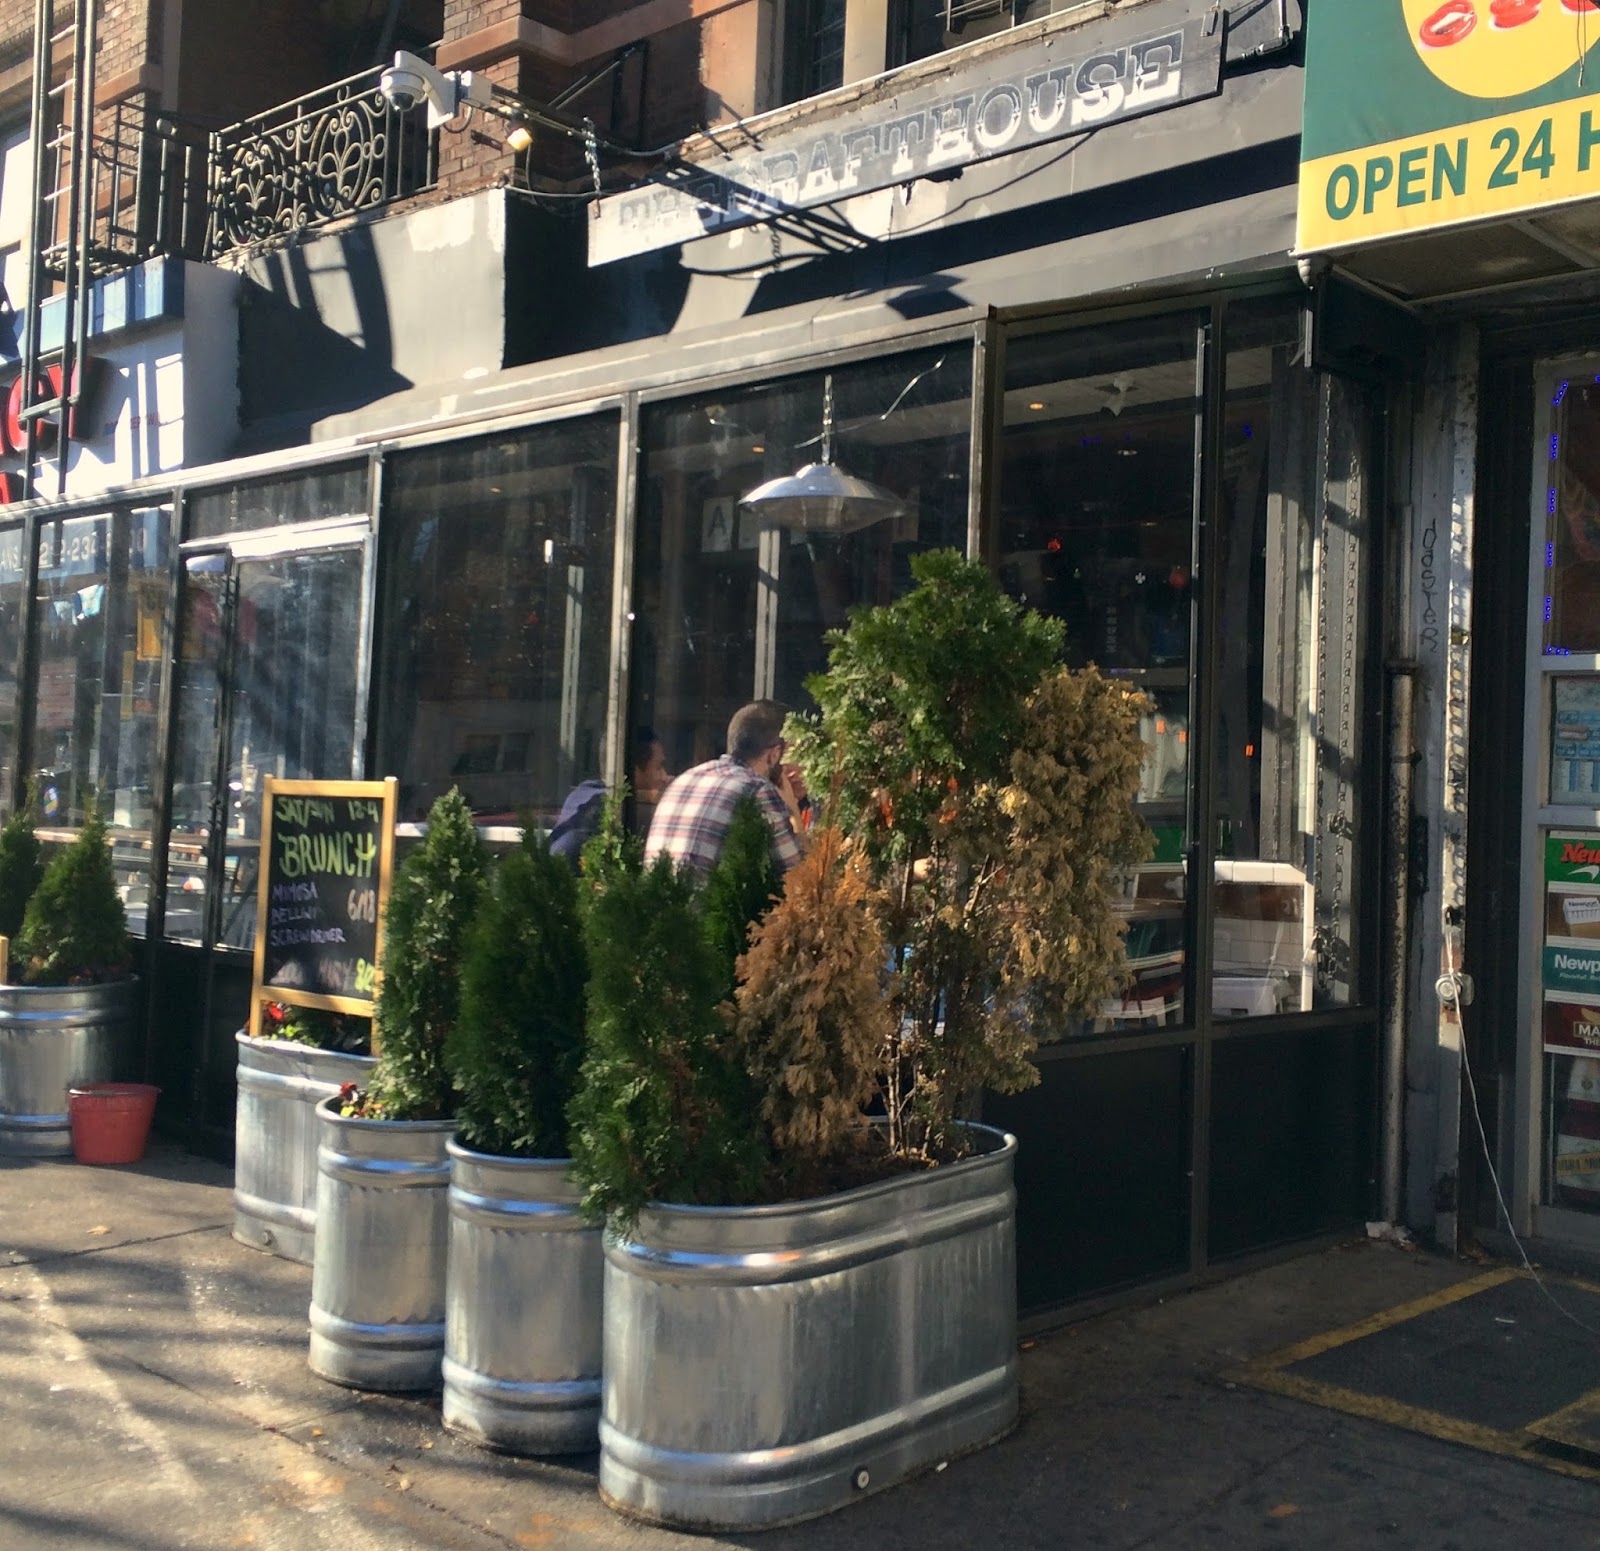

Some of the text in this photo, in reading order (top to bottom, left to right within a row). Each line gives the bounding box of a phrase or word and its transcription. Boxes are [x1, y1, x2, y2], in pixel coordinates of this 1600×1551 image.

[1325, 137, 1468, 221] OPEN
[1487, 118, 1555, 190] 24
[277, 831, 377, 878] BRUNCH
[1554, 953, 1600, 974] Newp
